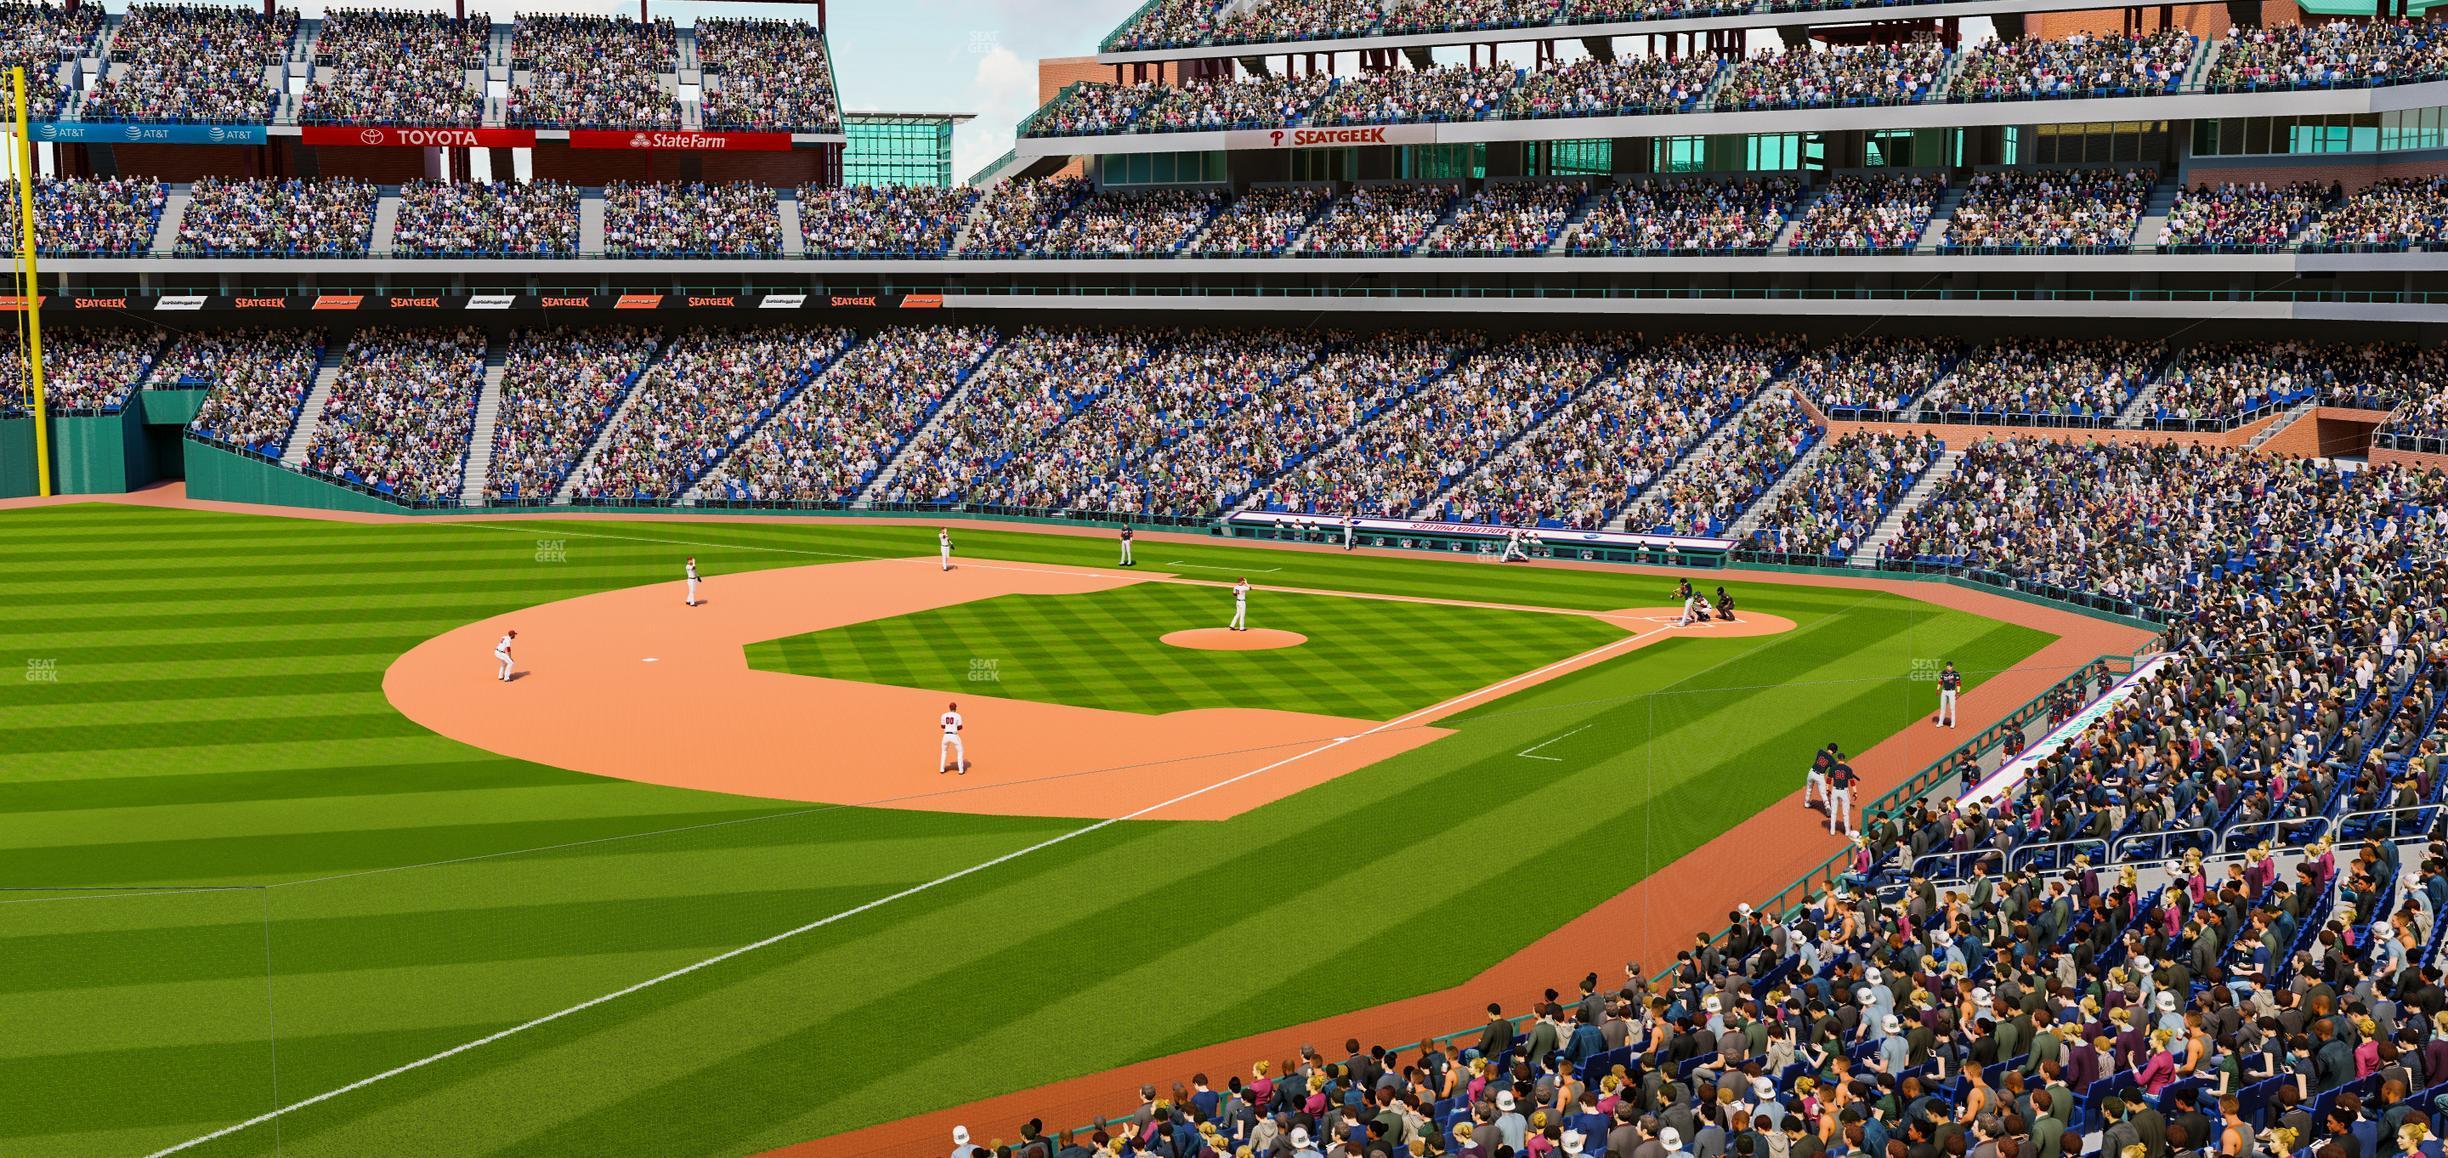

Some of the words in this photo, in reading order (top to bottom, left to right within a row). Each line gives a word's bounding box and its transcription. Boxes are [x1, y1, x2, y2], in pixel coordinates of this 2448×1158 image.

[59, 128, 85, 137] AT&T
[143, 129, 168, 138] AT&T
[226, 130, 252, 139] AT&T
[397, 130, 479, 146] TOYOTA
[1294, 127, 1386, 145] SEATGEEK
[75, 298, 127, 309] SEATGEEK
[235, 297, 286, 308] SEATGEEK
[390, 297, 440, 308] SEATGEEK
[541, 297, 590, 307] SEATGEEK
[688, 296, 735, 307] SEATGEEK
[831, 296, 876, 307] SEATGEEK
